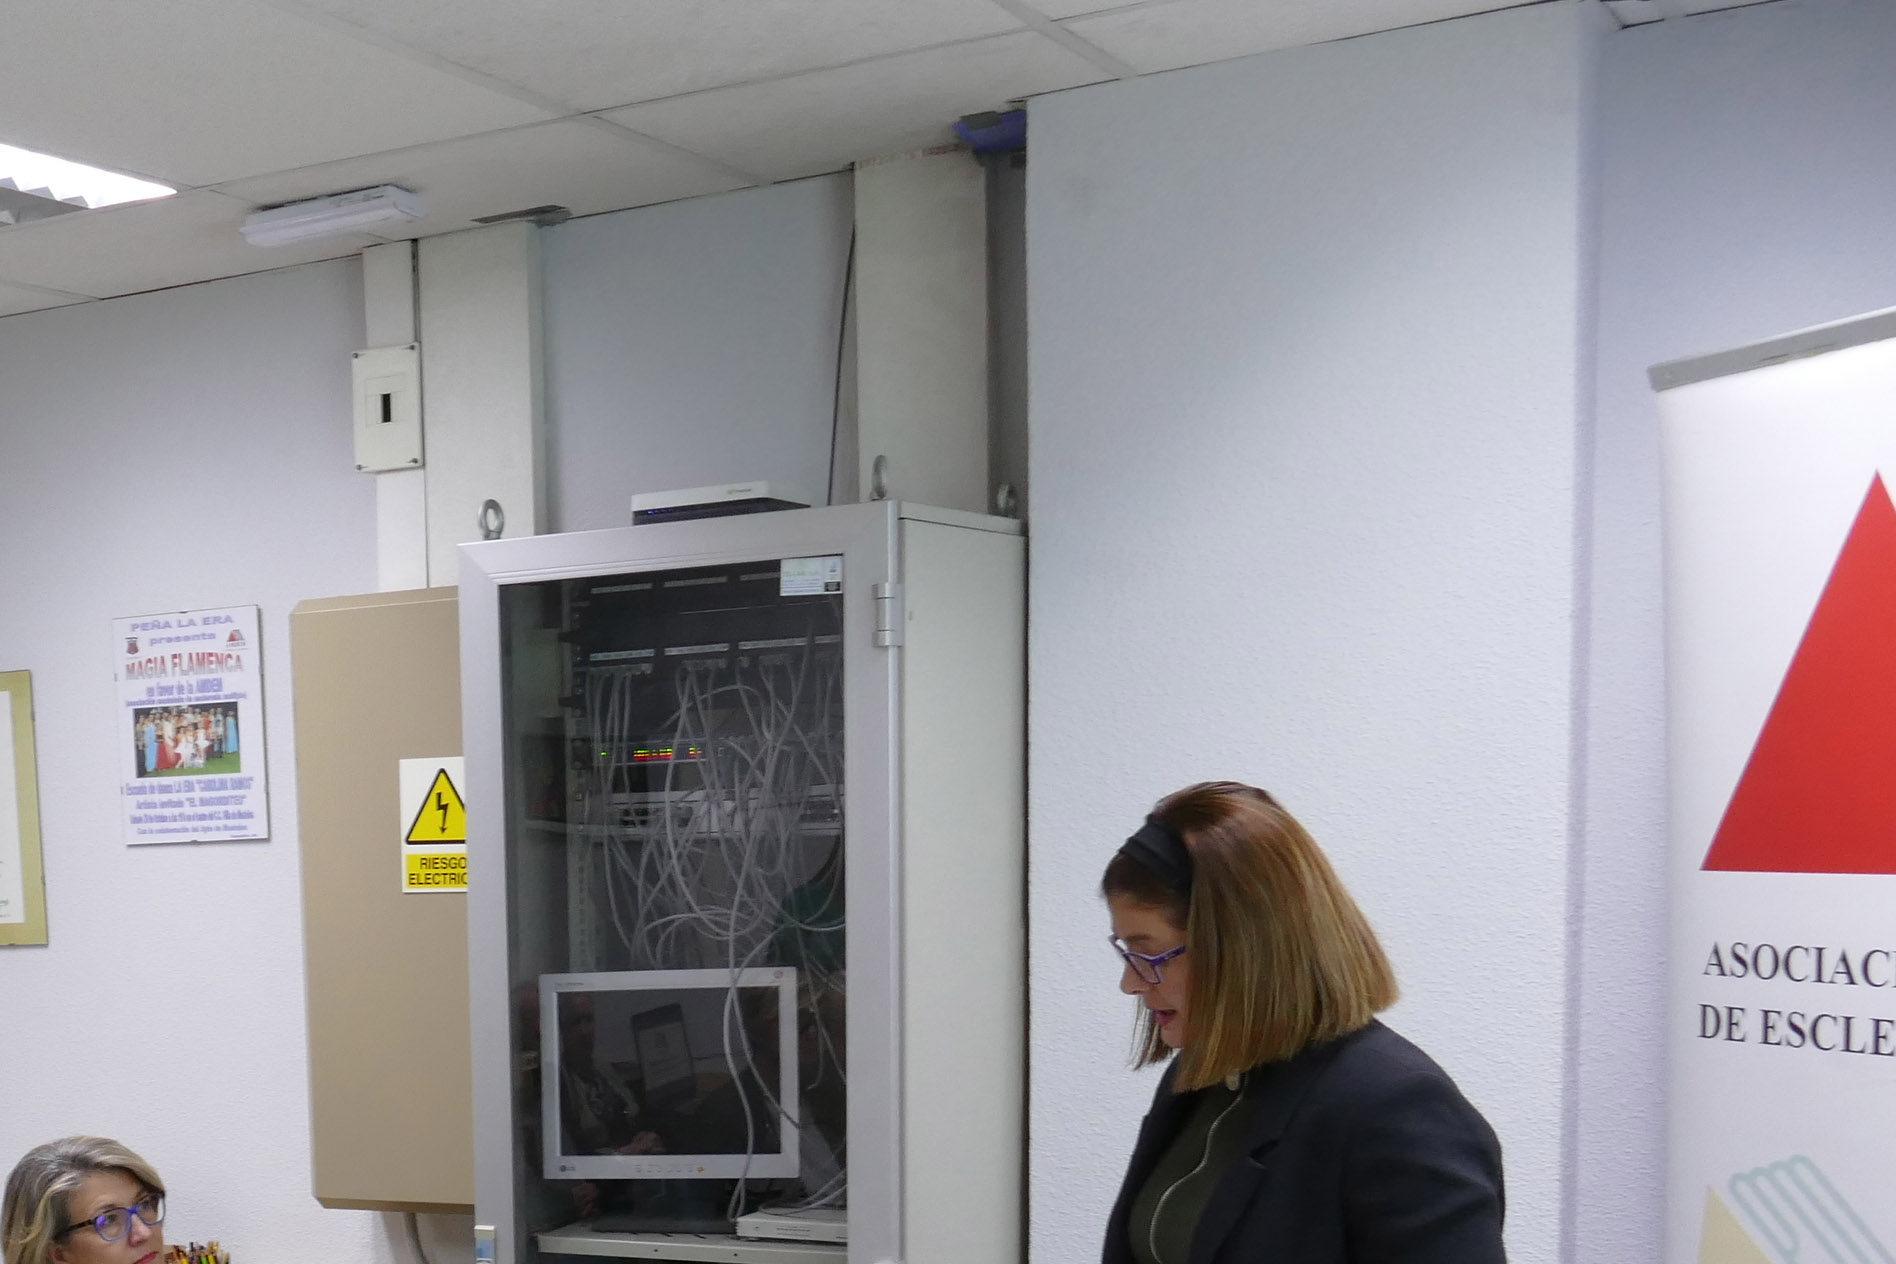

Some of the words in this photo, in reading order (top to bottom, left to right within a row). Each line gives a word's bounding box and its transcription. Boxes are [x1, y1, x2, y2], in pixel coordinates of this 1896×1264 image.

[130, 620, 172, 632] PEÑA
[177, 618, 197, 628] LA
[202, 615, 234, 626] ERA
[150, 633, 216, 646] presenta
[126, 656, 167, 680] MAGIA
[171, 651, 243, 677] FLAMENCA
[420, 857, 467, 869] RIESGO
[1702, 941, 1896, 988] ASOCIAC
[1697, 1003, 1746, 1042] DE
[1759, 1008, 1896, 1057] ESCLE
